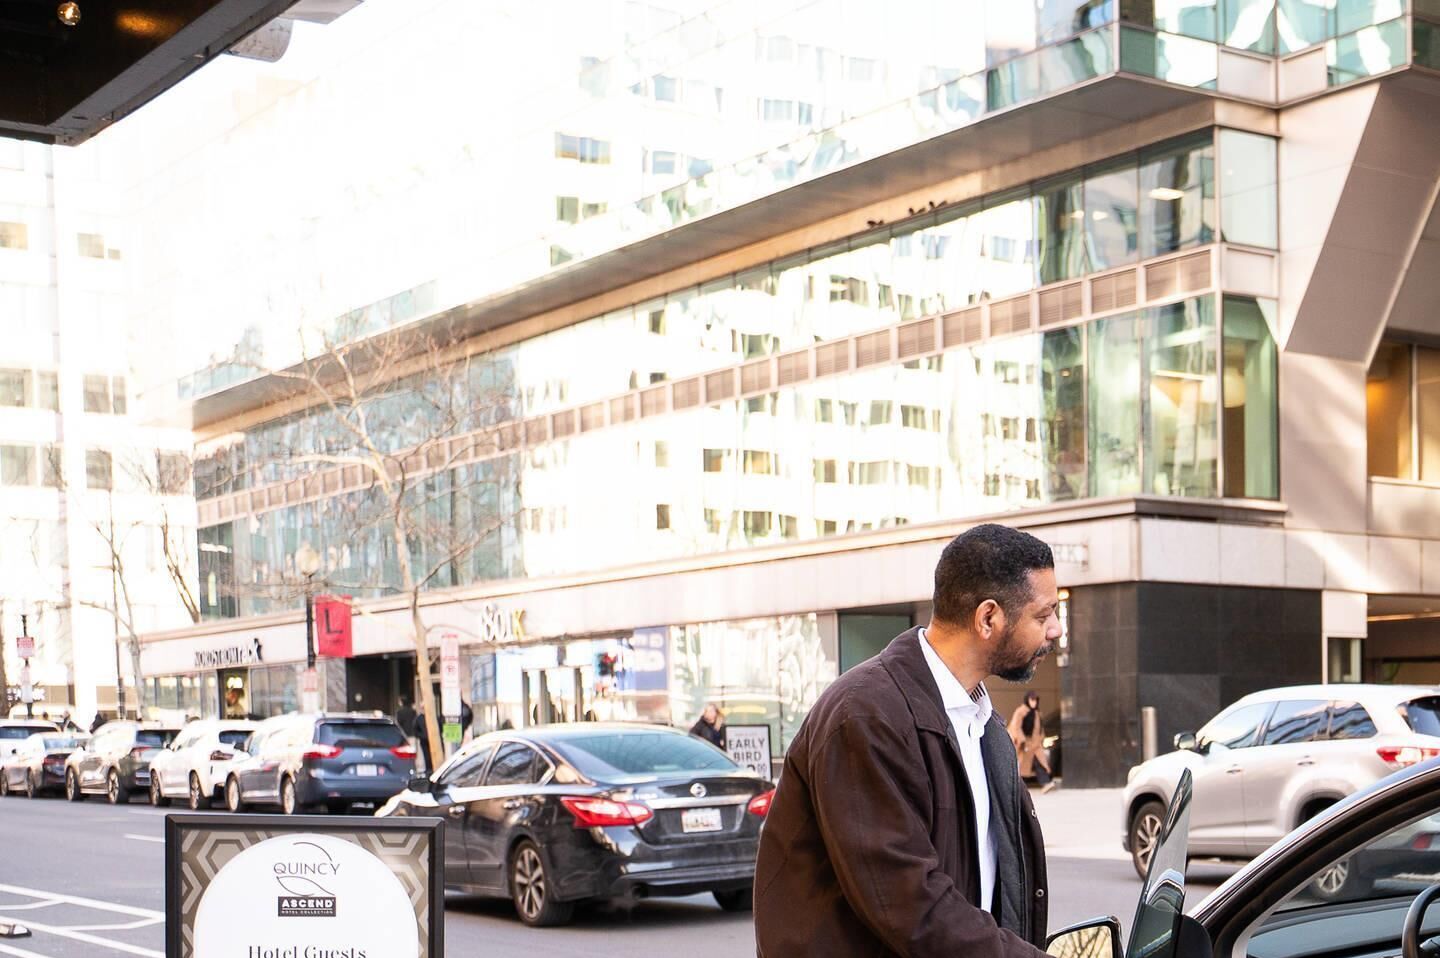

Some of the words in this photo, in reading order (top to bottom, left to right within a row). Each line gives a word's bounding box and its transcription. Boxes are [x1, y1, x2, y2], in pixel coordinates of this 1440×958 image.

[728, 738, 765, 750] EARLY
[733, 751, 762, 762] BIRD
[273, 862, 340, 875] QUINCY
[282, 899, 334, 908] ASCEND
